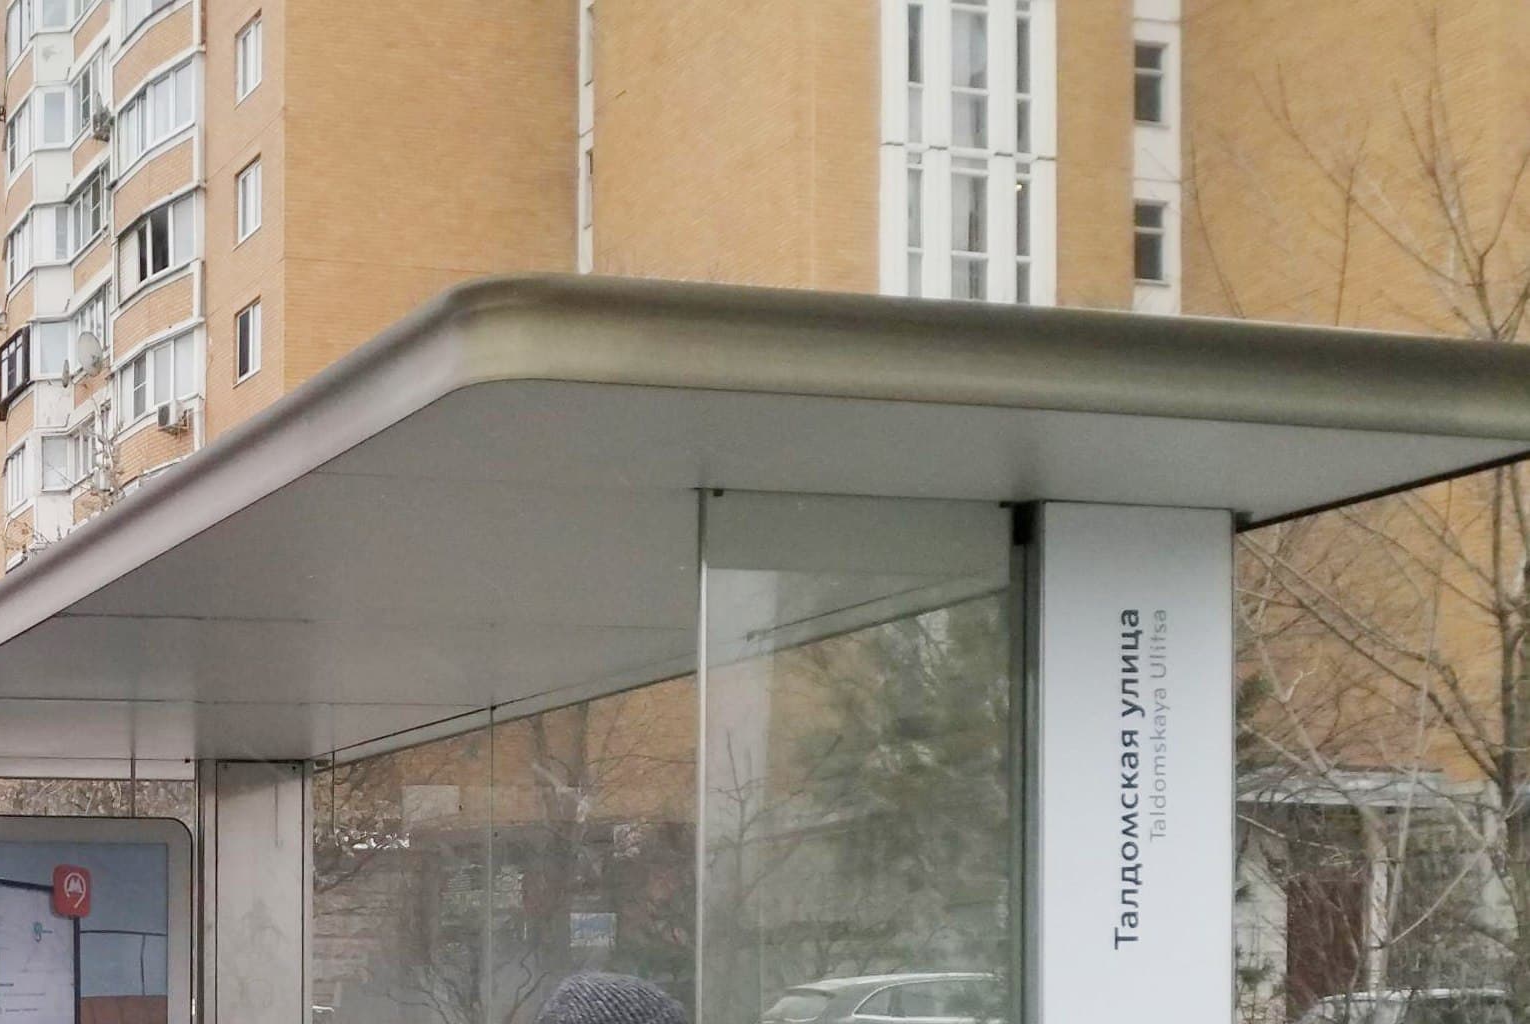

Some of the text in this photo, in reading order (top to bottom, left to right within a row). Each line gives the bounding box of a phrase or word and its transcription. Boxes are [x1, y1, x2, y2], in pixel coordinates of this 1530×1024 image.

[1114, 608, 1146, 950] Талдомская улица
[1149, 608, 1170, 842] Taldomskaya Ulitsa
